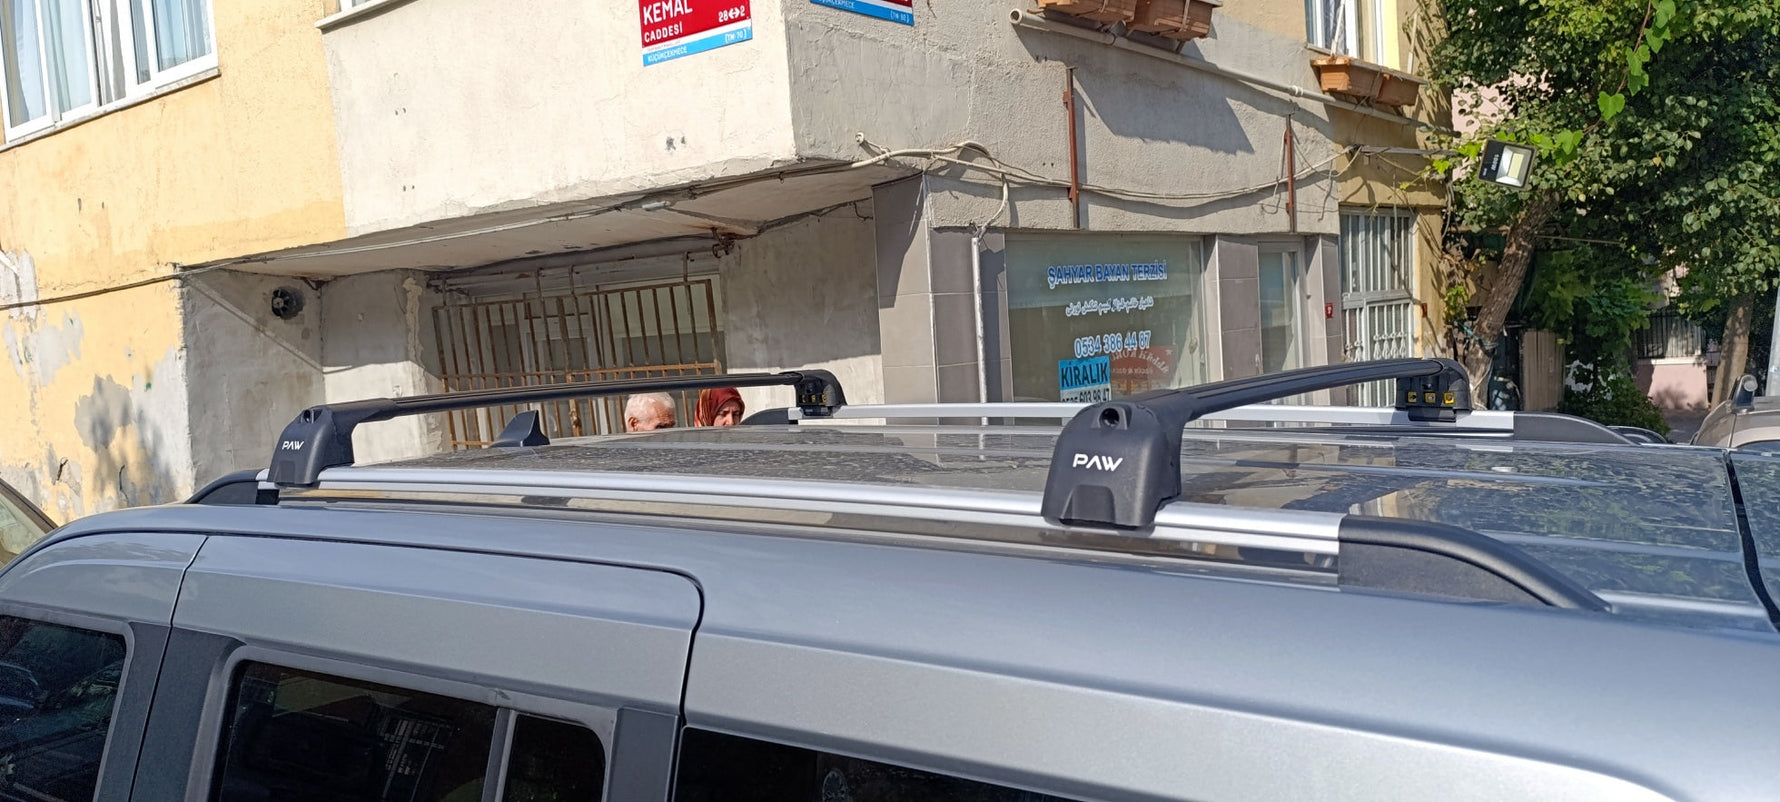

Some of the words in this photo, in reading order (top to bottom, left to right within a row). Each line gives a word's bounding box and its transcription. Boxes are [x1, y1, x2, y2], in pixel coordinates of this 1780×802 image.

[643, 0, 693, 25] KEMAL
[644, 21, 683, 43] CADDESİ
[1047, 265, 1095, 290] ŞAHYAR
[1095, 263, 1130, 283] BAYAN
[1131, 259, 1168, 281] TERZİSİ
[1074, 335, 1101, 359] 0534
[1103, 332, 1123, 355] 386
[1124, 331, 1138, 351] 44
[1138, 329, 1152, 350] 87
[1061, 361, 1109, 388] KİRALIK
[282, 440, 305, 450] PAW
[1072, 453, 1123, 472] PAW
